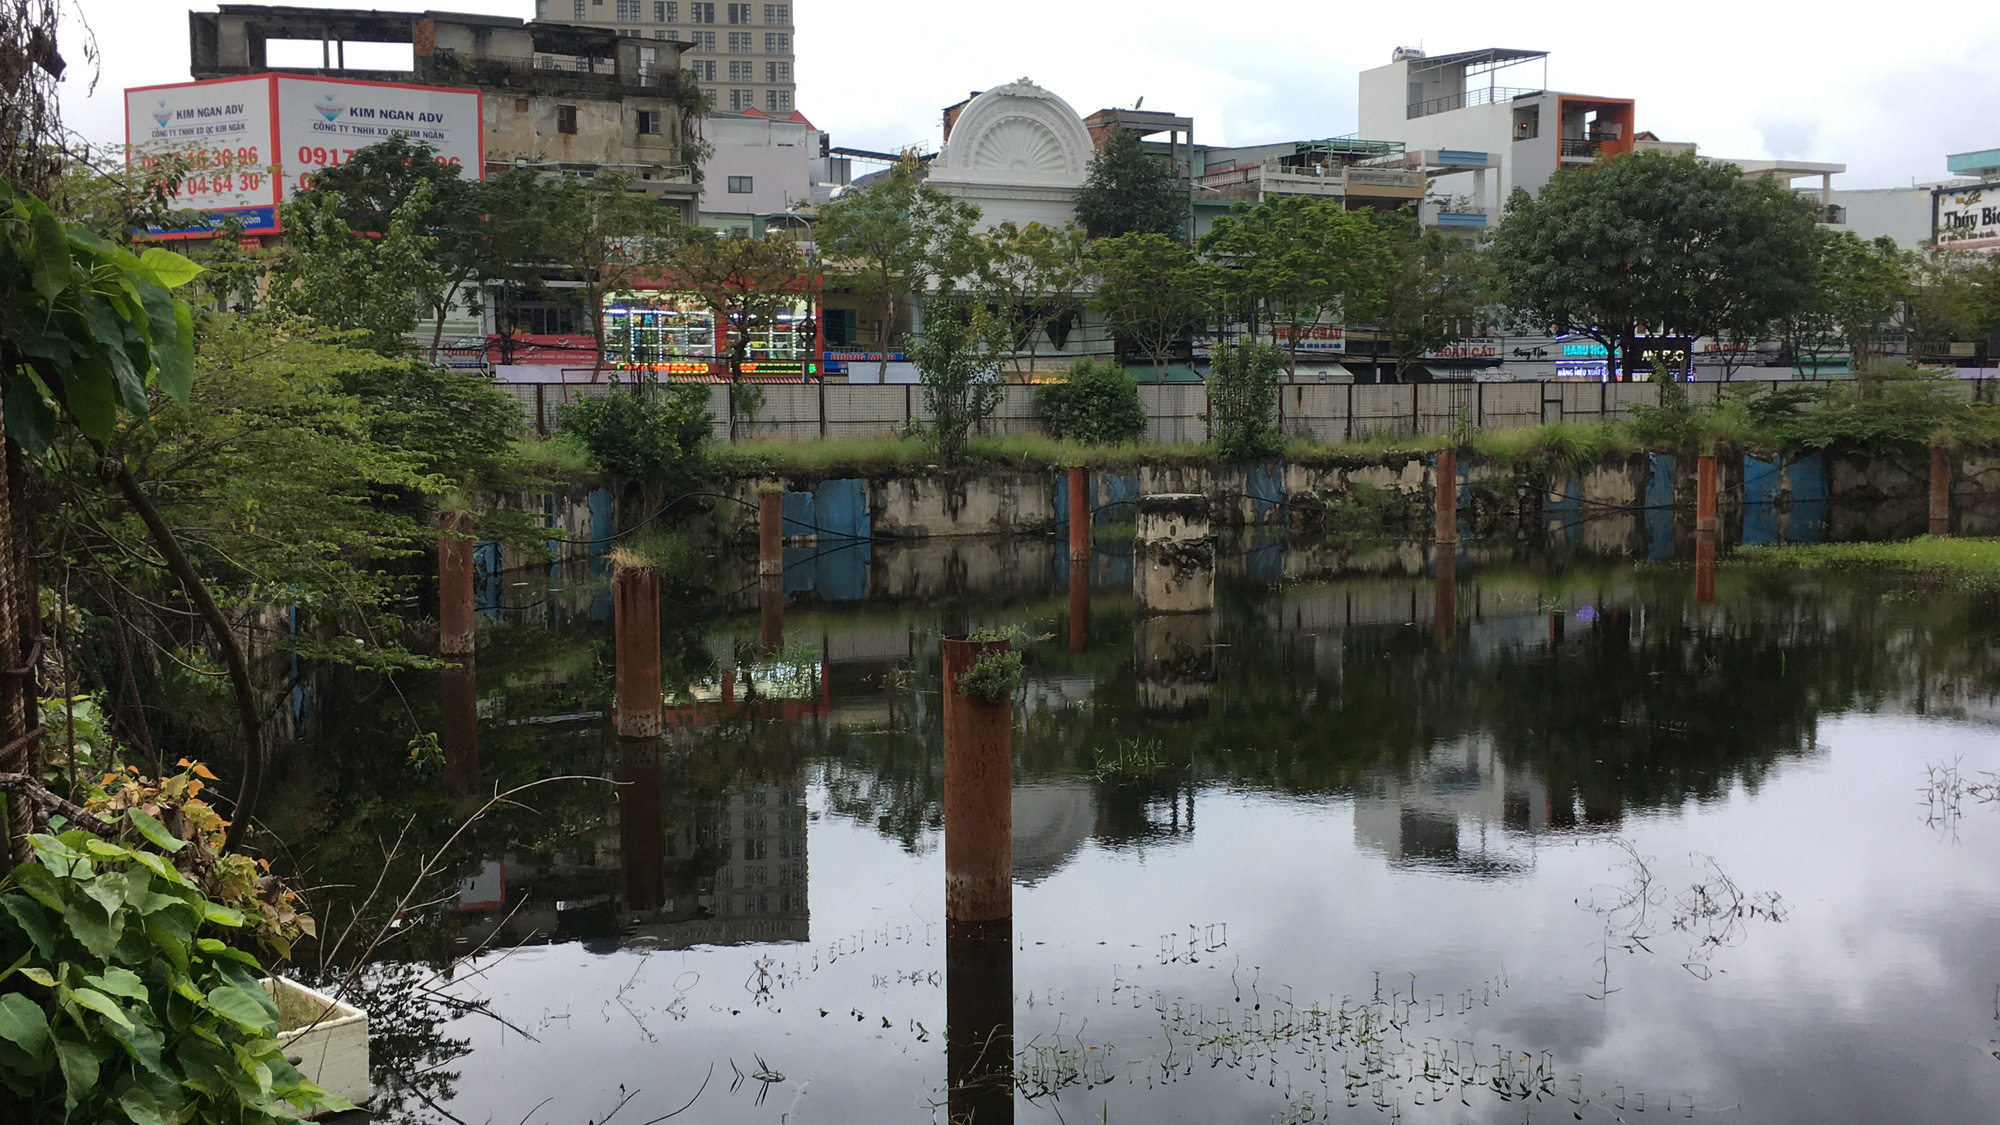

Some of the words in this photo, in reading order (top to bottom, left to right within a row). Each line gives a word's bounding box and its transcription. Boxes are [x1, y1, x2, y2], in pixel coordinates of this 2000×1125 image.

[176, 109, 194, 120] KIM
[197, 106, 223, 118] NGAN
[225, 104, 244, 115] ADV
[350, 107, 375, 119] KIM
[379, 109, 414, 121] NGAN
[418, 112, 444, 124] ADV
[152, 127, 168, 138] CÔNG
[169, 128, 177, 137] TY
[178, 127, 194, 136] TNHH
[196, 126, 205, 135] XD
[205, 125, 215, 135] QC
[215, 124, 227, 133] KIM
[229, 121, 245, 132] NGÂN
[313, 121, 336, 132] CÔNG
[339, 124, 349, 133] TY
[352, 126, 375, 136] TNHH
[377, 127, 388, 136] XD
[422, 129, 445, 140] NGÂN
[237, 146, 259, 166] 96
[298, 145, 356, 167] 0917
[187, 176, 207, 195] 04
[213, 175, 233, 193] 64
[239, 173, 260, 192] 30
[1944, 210, 1978, 231] Thúy
